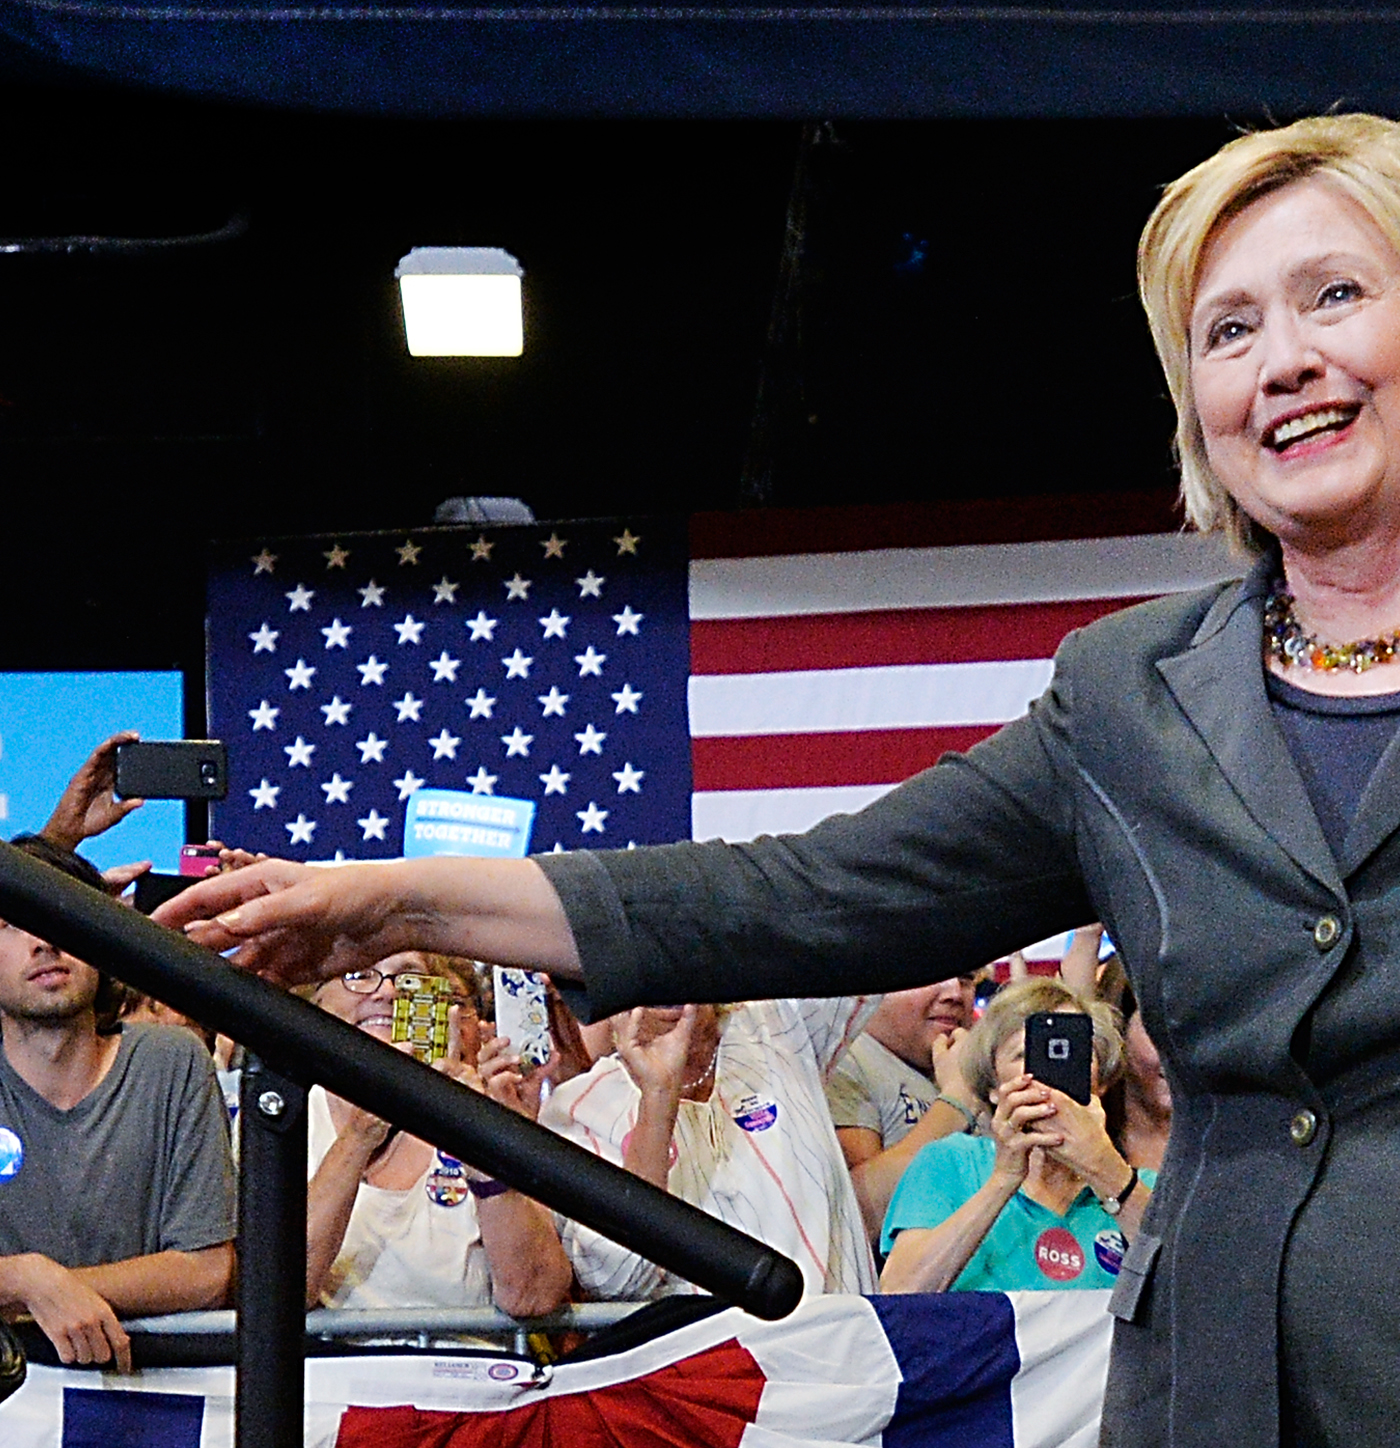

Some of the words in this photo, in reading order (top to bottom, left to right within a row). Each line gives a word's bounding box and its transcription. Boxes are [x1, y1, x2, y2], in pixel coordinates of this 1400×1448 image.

[415, 799, 516, 826] STRONGER
[413, 823, 513, 849] TOGETHER
[1038, 1246, 1081, 1267] ROSS
